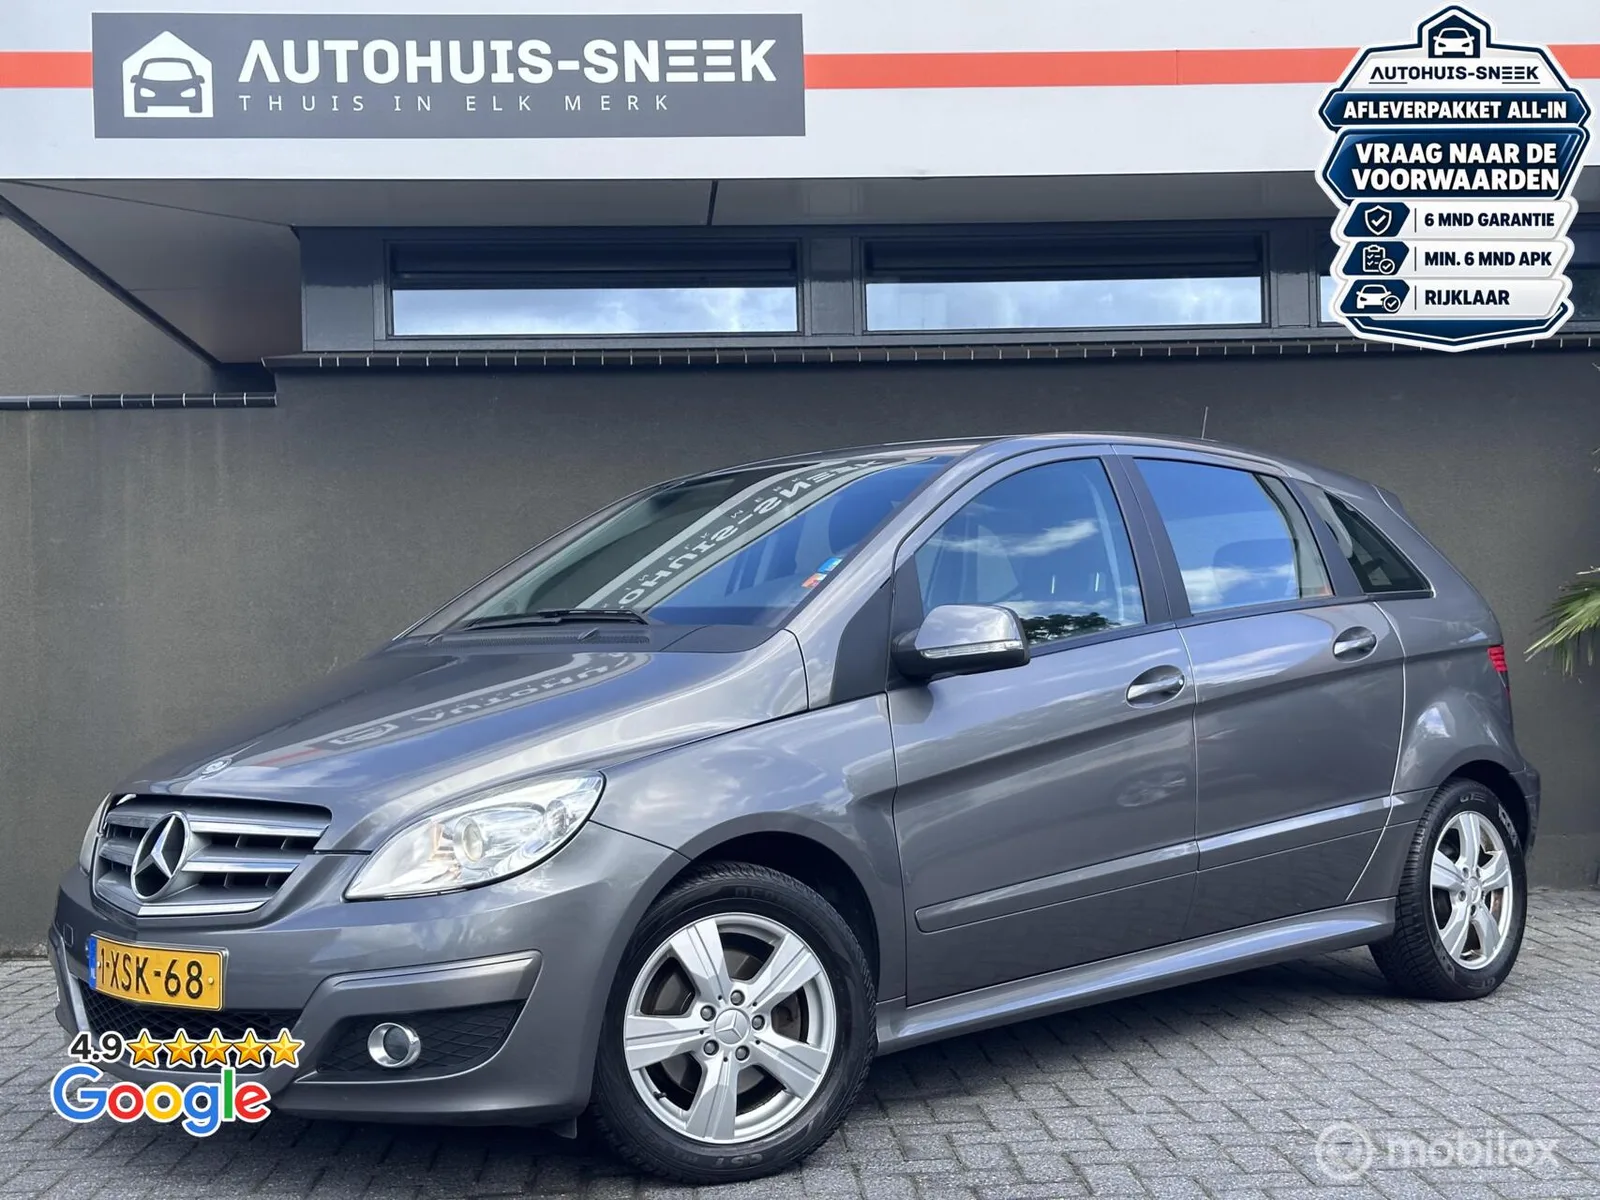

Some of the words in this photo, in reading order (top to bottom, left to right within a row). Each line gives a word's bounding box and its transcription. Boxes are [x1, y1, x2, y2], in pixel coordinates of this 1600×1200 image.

[238, 39, 777, 84] AUTOHUIS-SNEEK
[239, 95, 364, 112] THUIS
[394, 95, 431, 112] IN
[466, 95, 532, 112] ELK
[565, 95, 668, 112] MERK
[99, 947, 203, 999] 1-XSK-68
